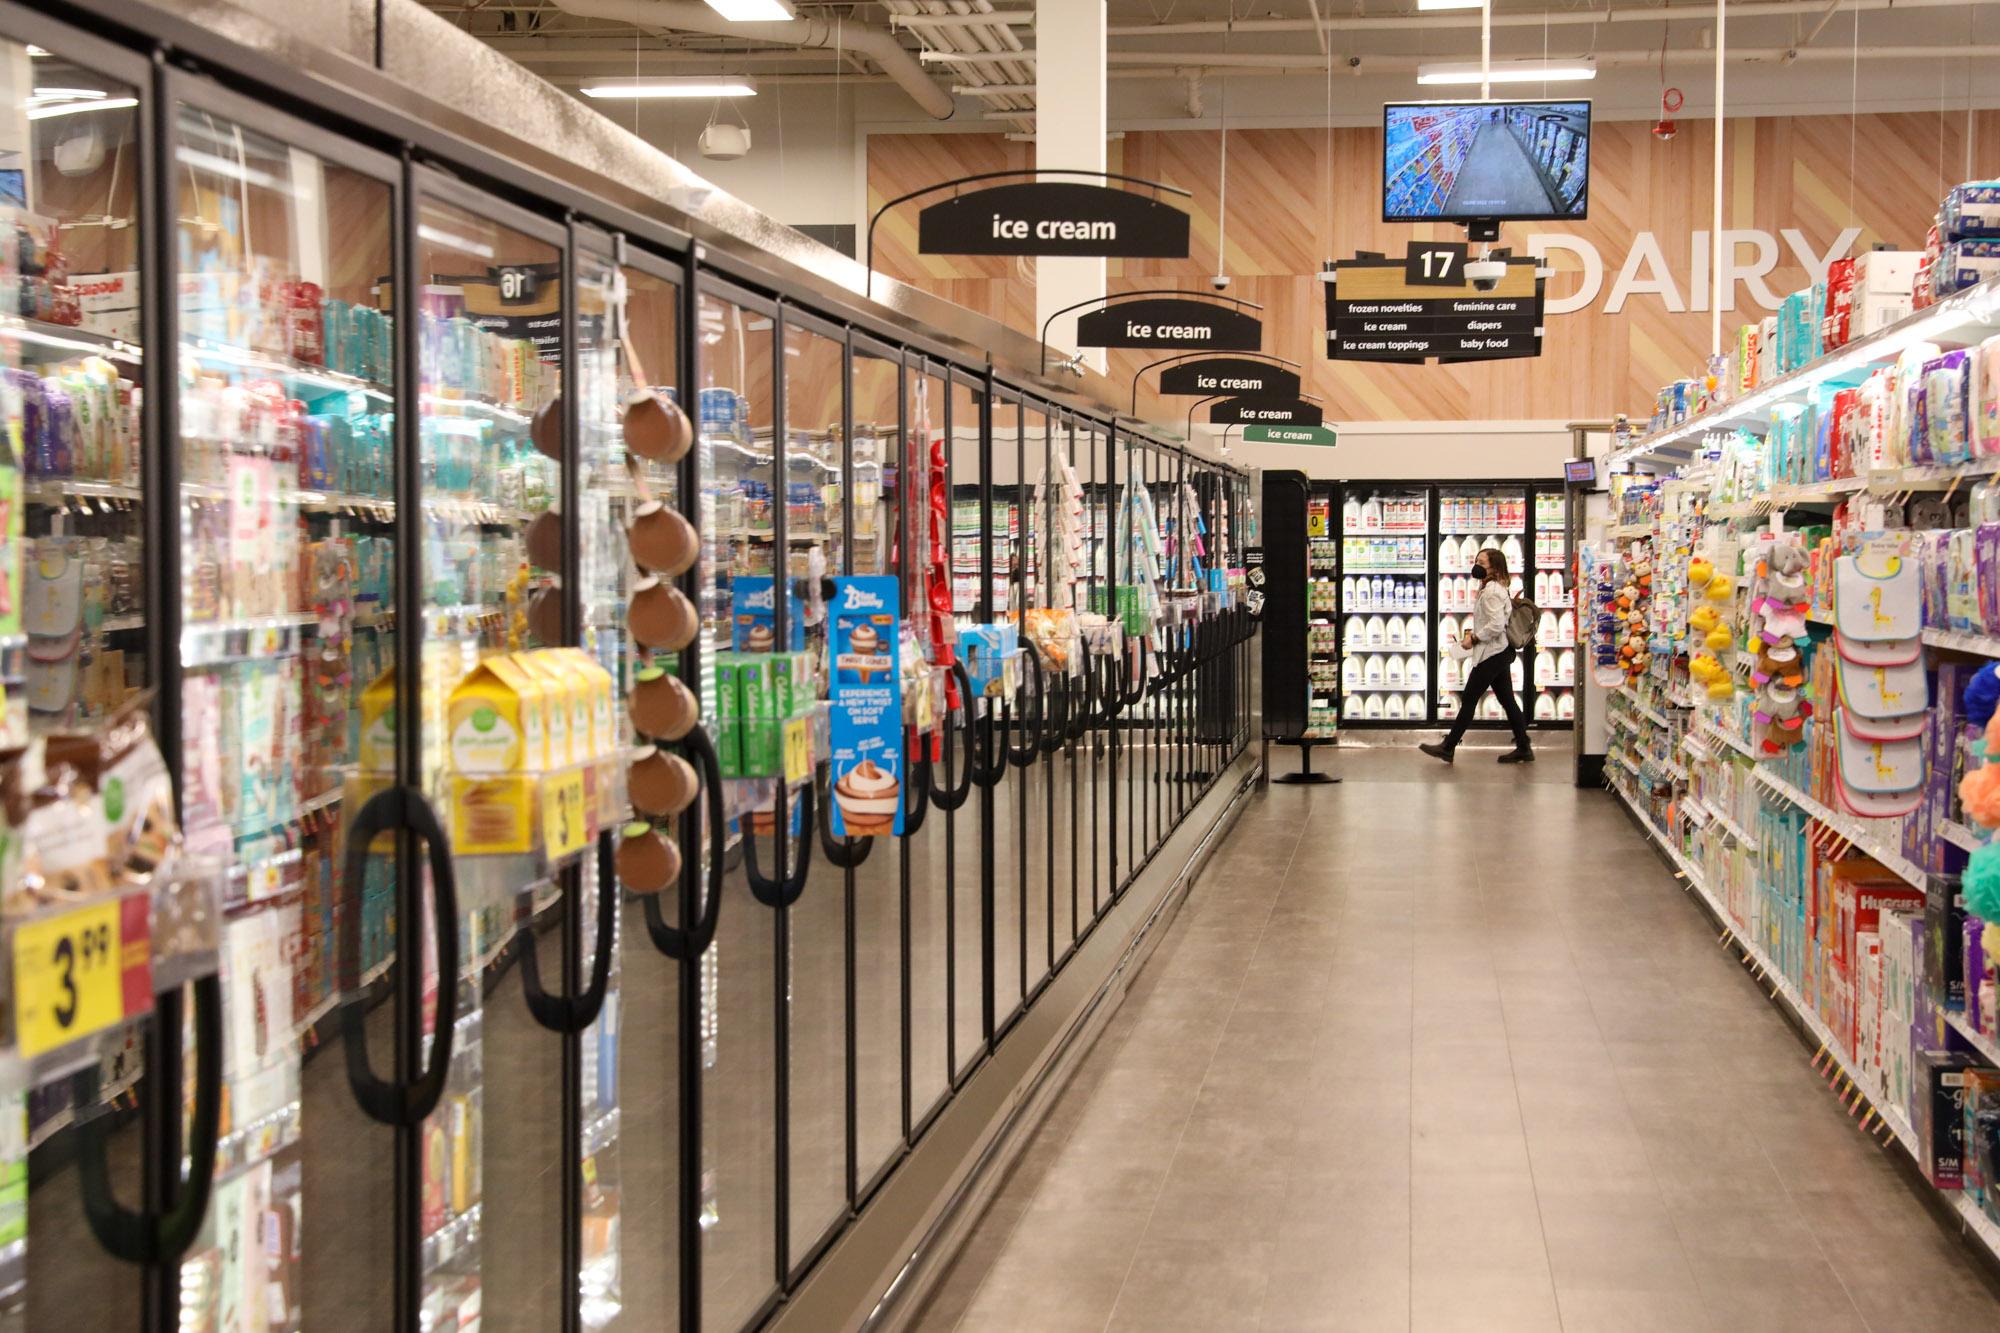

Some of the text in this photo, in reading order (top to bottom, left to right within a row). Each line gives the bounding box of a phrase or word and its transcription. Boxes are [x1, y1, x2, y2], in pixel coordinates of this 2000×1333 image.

[992, 214, 1117, 240] ice cream
[1420, 251, 1455, 278] 17
[1527, 228, 1863, 315] DAIRY
[1348, 302, 1423, 314] frozen novelties
[1453, 302, 1517, 312] feminine care
[1126, 321, 1212, 340] ice cream
[1363, 322, 1408, 332] ice cream
[1467, 320, 1502, 332] diapers
[1343, 340, 1429, 352] ice cream toppings
[1460, 338, 1509, 350] baby food
[1197, 375, 1262, 391] ice cream
[1239, 407, 1293, 421] ice cream
[1267, 429, 1313, 441] ice cream
[1860, 895, 1921, 910] HUGGIES
[54, 935, 77, 1029] 3
[1938, 1157, 1959, 1168] S/M
